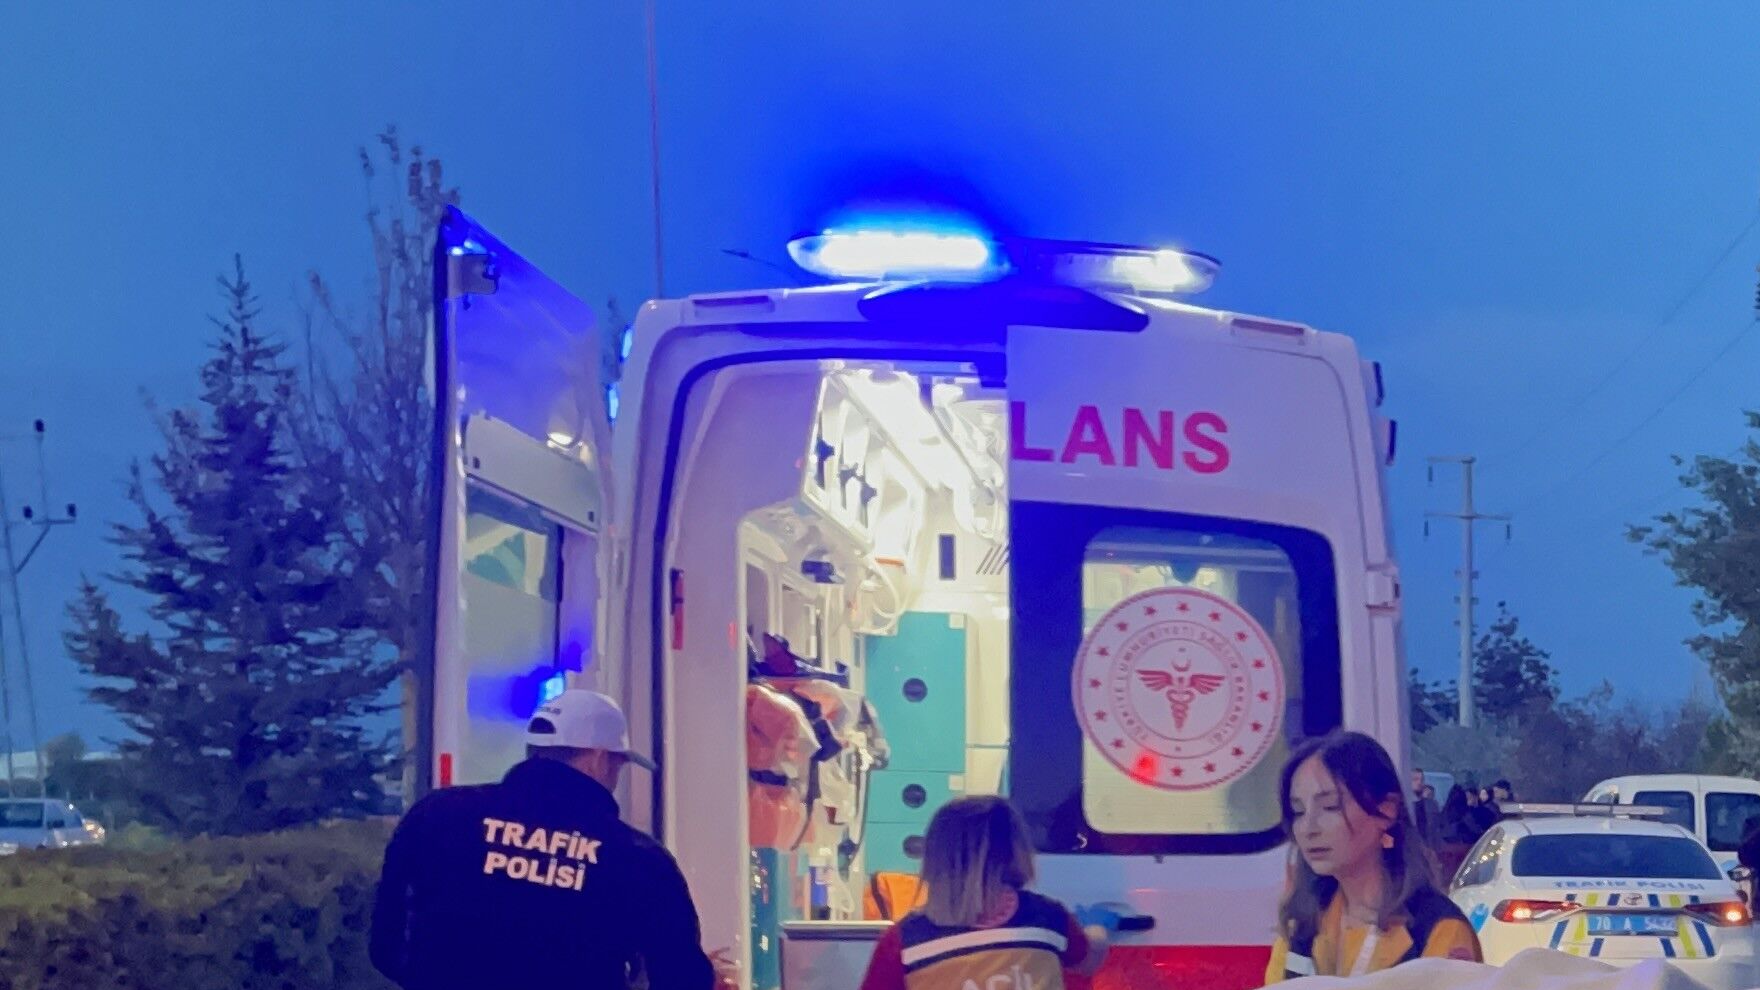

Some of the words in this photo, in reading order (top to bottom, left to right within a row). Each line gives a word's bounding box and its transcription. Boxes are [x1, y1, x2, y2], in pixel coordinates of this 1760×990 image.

[1010, 400, 1231, 474] LANS
[483, 817, 602, 864] TRAFİK
[483, 851, 586, 891] POLİSİ
